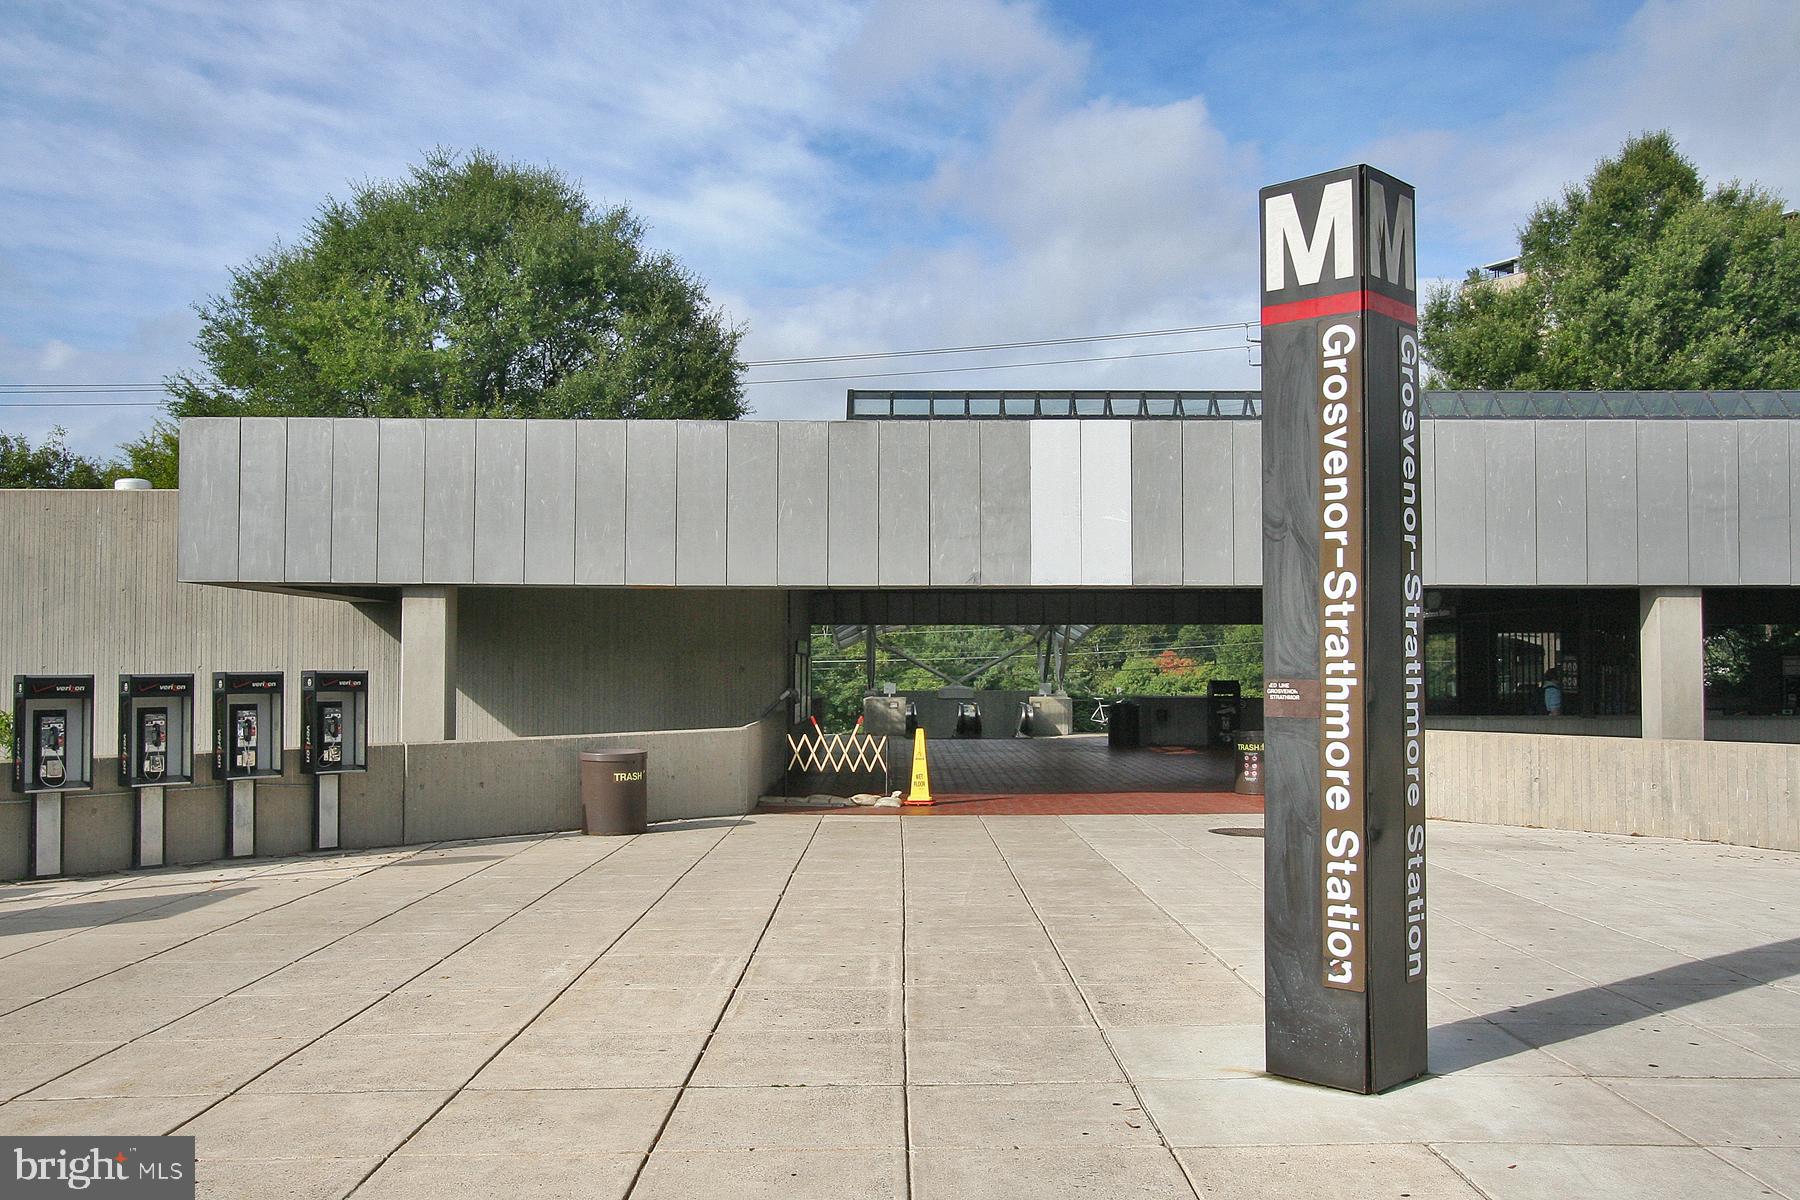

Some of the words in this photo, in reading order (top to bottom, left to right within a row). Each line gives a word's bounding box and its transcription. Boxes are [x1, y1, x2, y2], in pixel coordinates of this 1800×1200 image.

[1265, 178, 1354, 292] M
[1369, 178, 1414, 292] M
[251, 681, 277, 689] verizon
[339, 679, 362, 688] verizon
[56, 684, 86, 693] verizon
[159, 684, 187, 693] verizon
[1237, 743, 1260, 751] TRASH
[614, 772, 642, 781] TRASH
[1407, 824, 1424, 977] Station
[1325, 827, 1360, 984] Station
